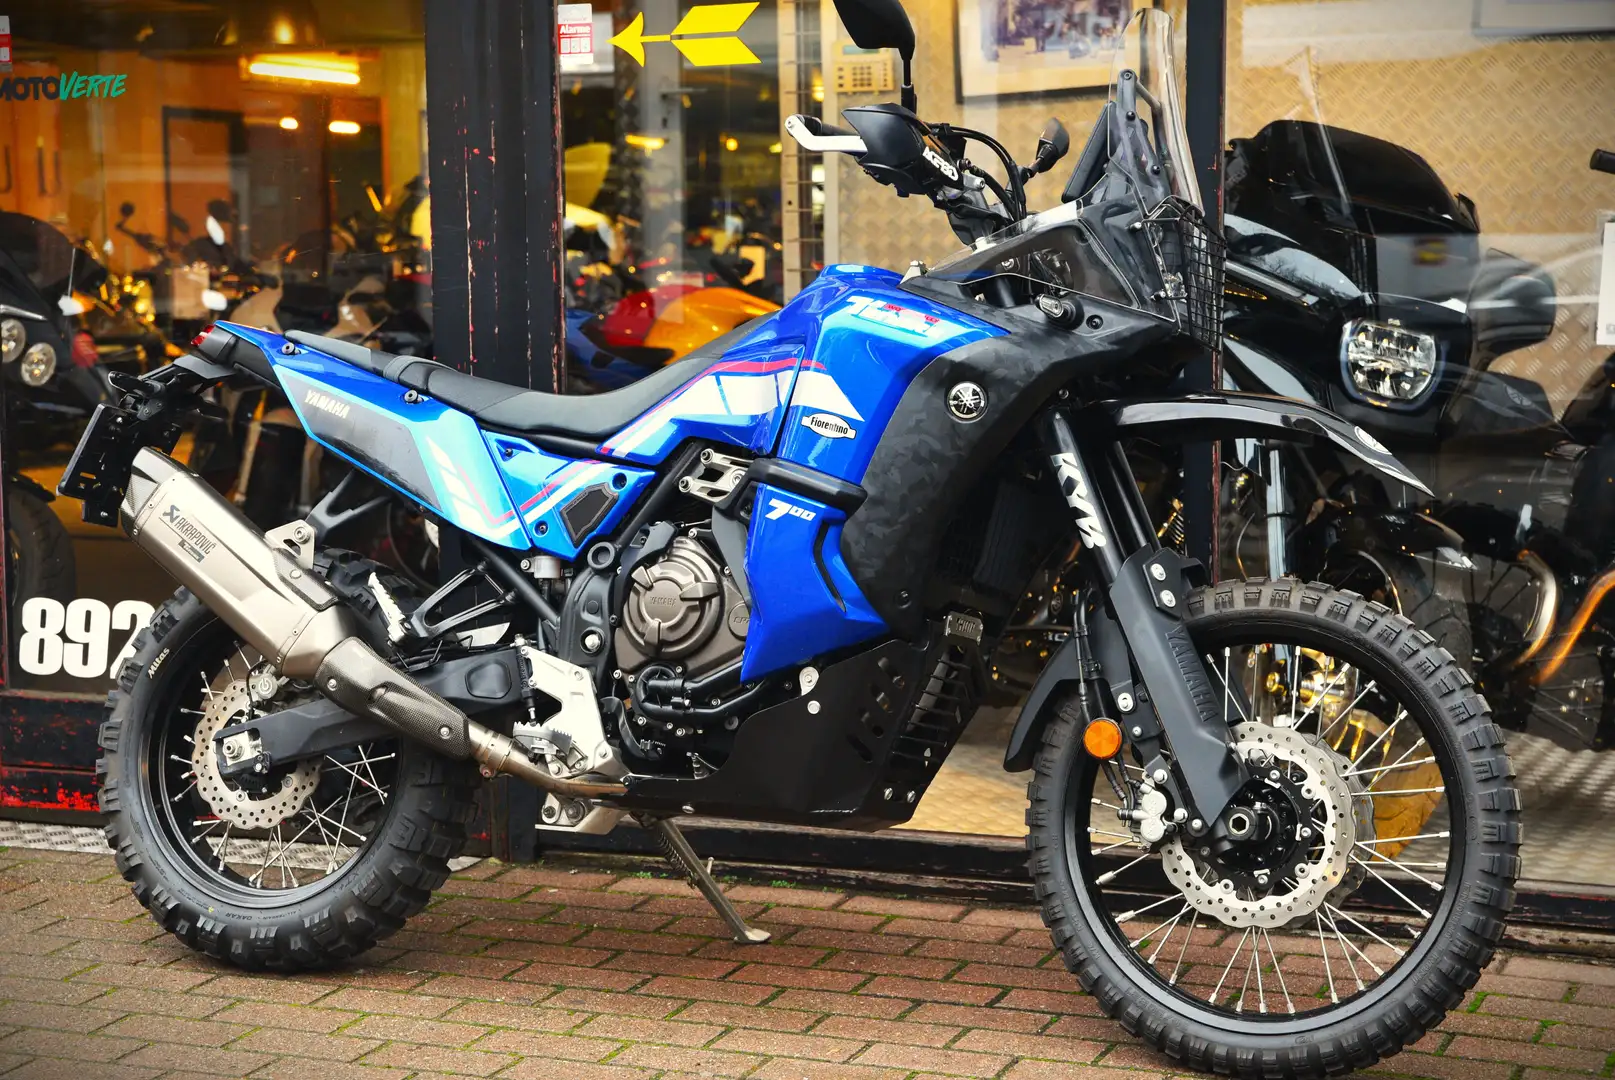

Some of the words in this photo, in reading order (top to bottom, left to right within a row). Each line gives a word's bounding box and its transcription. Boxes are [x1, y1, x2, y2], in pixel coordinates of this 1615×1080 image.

[560, 24, 591, 35] Alarme
[304, 389, 351, 419] YAMAHA
[810, 416, 849, 435] Fiorentino
[765, 498, 816, 521] 700
[1050, 452, 1107, 549] KYB
[147, 647, 170, 679] Mitas
[1164, 624, 1219, 723] YAMAHA
[225, 911, 253, 921] DAKAR
